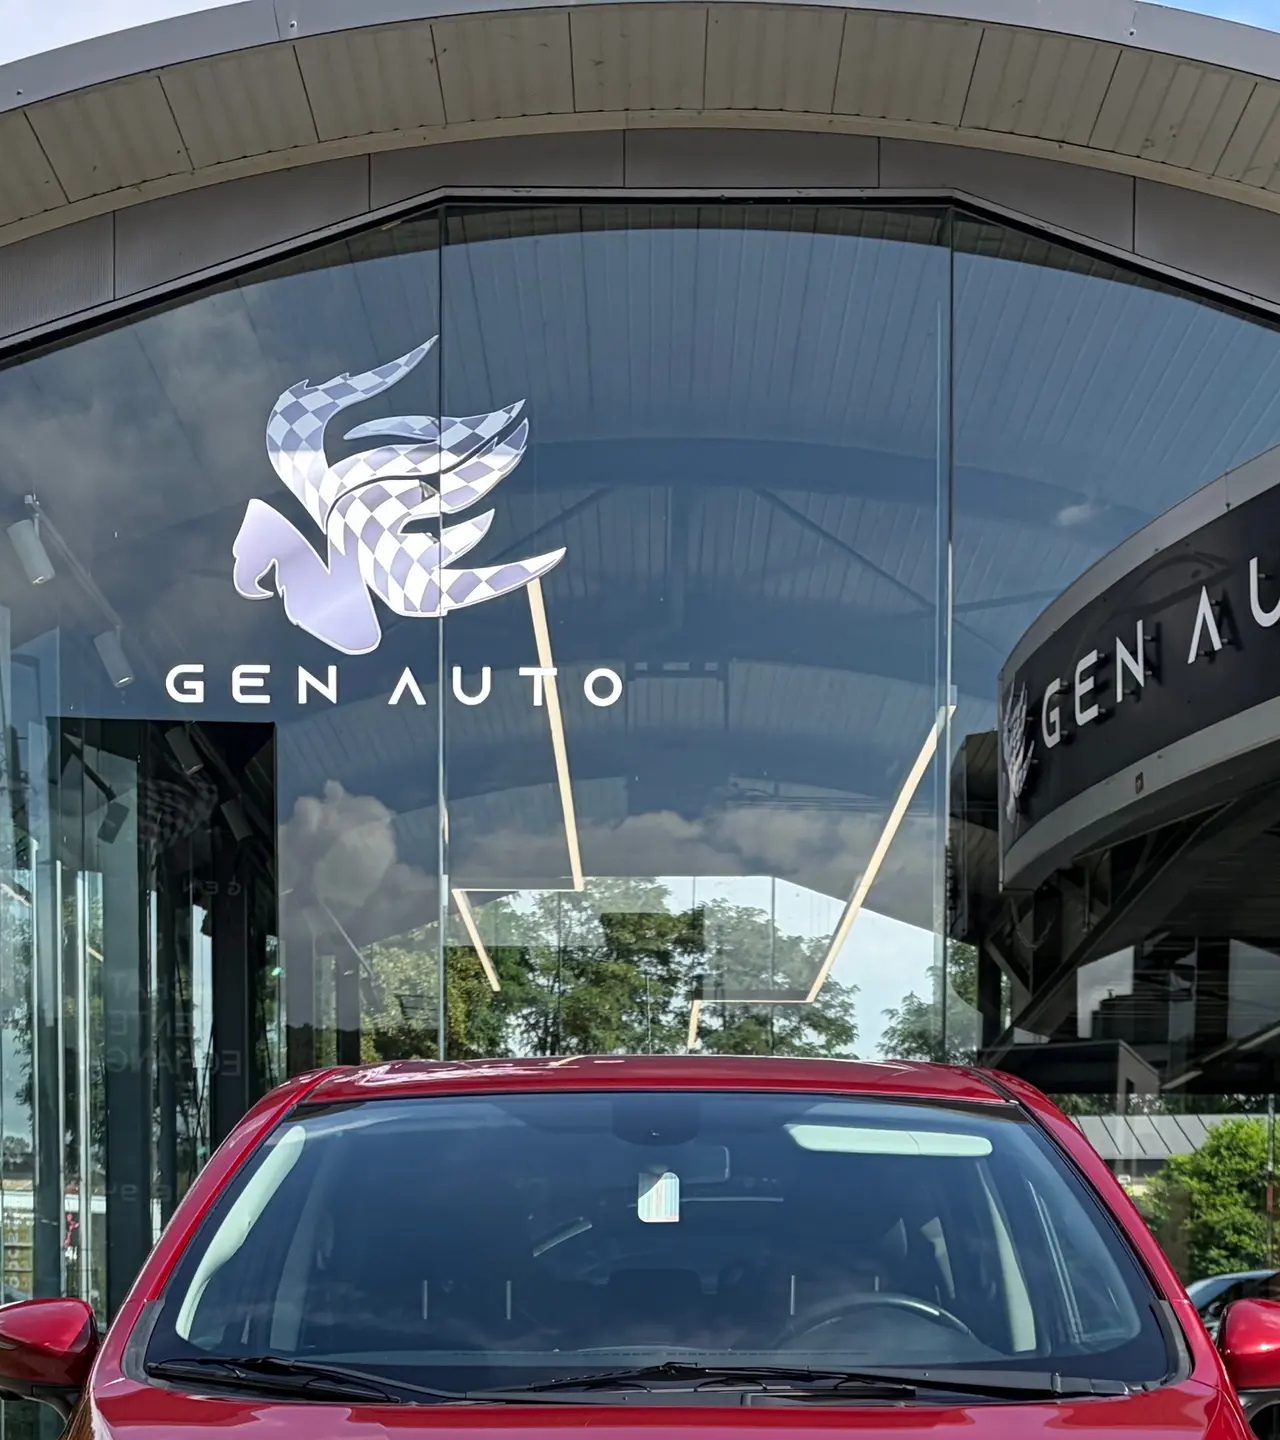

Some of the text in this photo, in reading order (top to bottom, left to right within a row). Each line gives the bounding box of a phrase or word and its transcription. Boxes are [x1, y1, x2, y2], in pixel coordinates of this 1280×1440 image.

[165, 664, 623, 707] GEN AUTO
[1041, 618, 1146, 749] GEN
